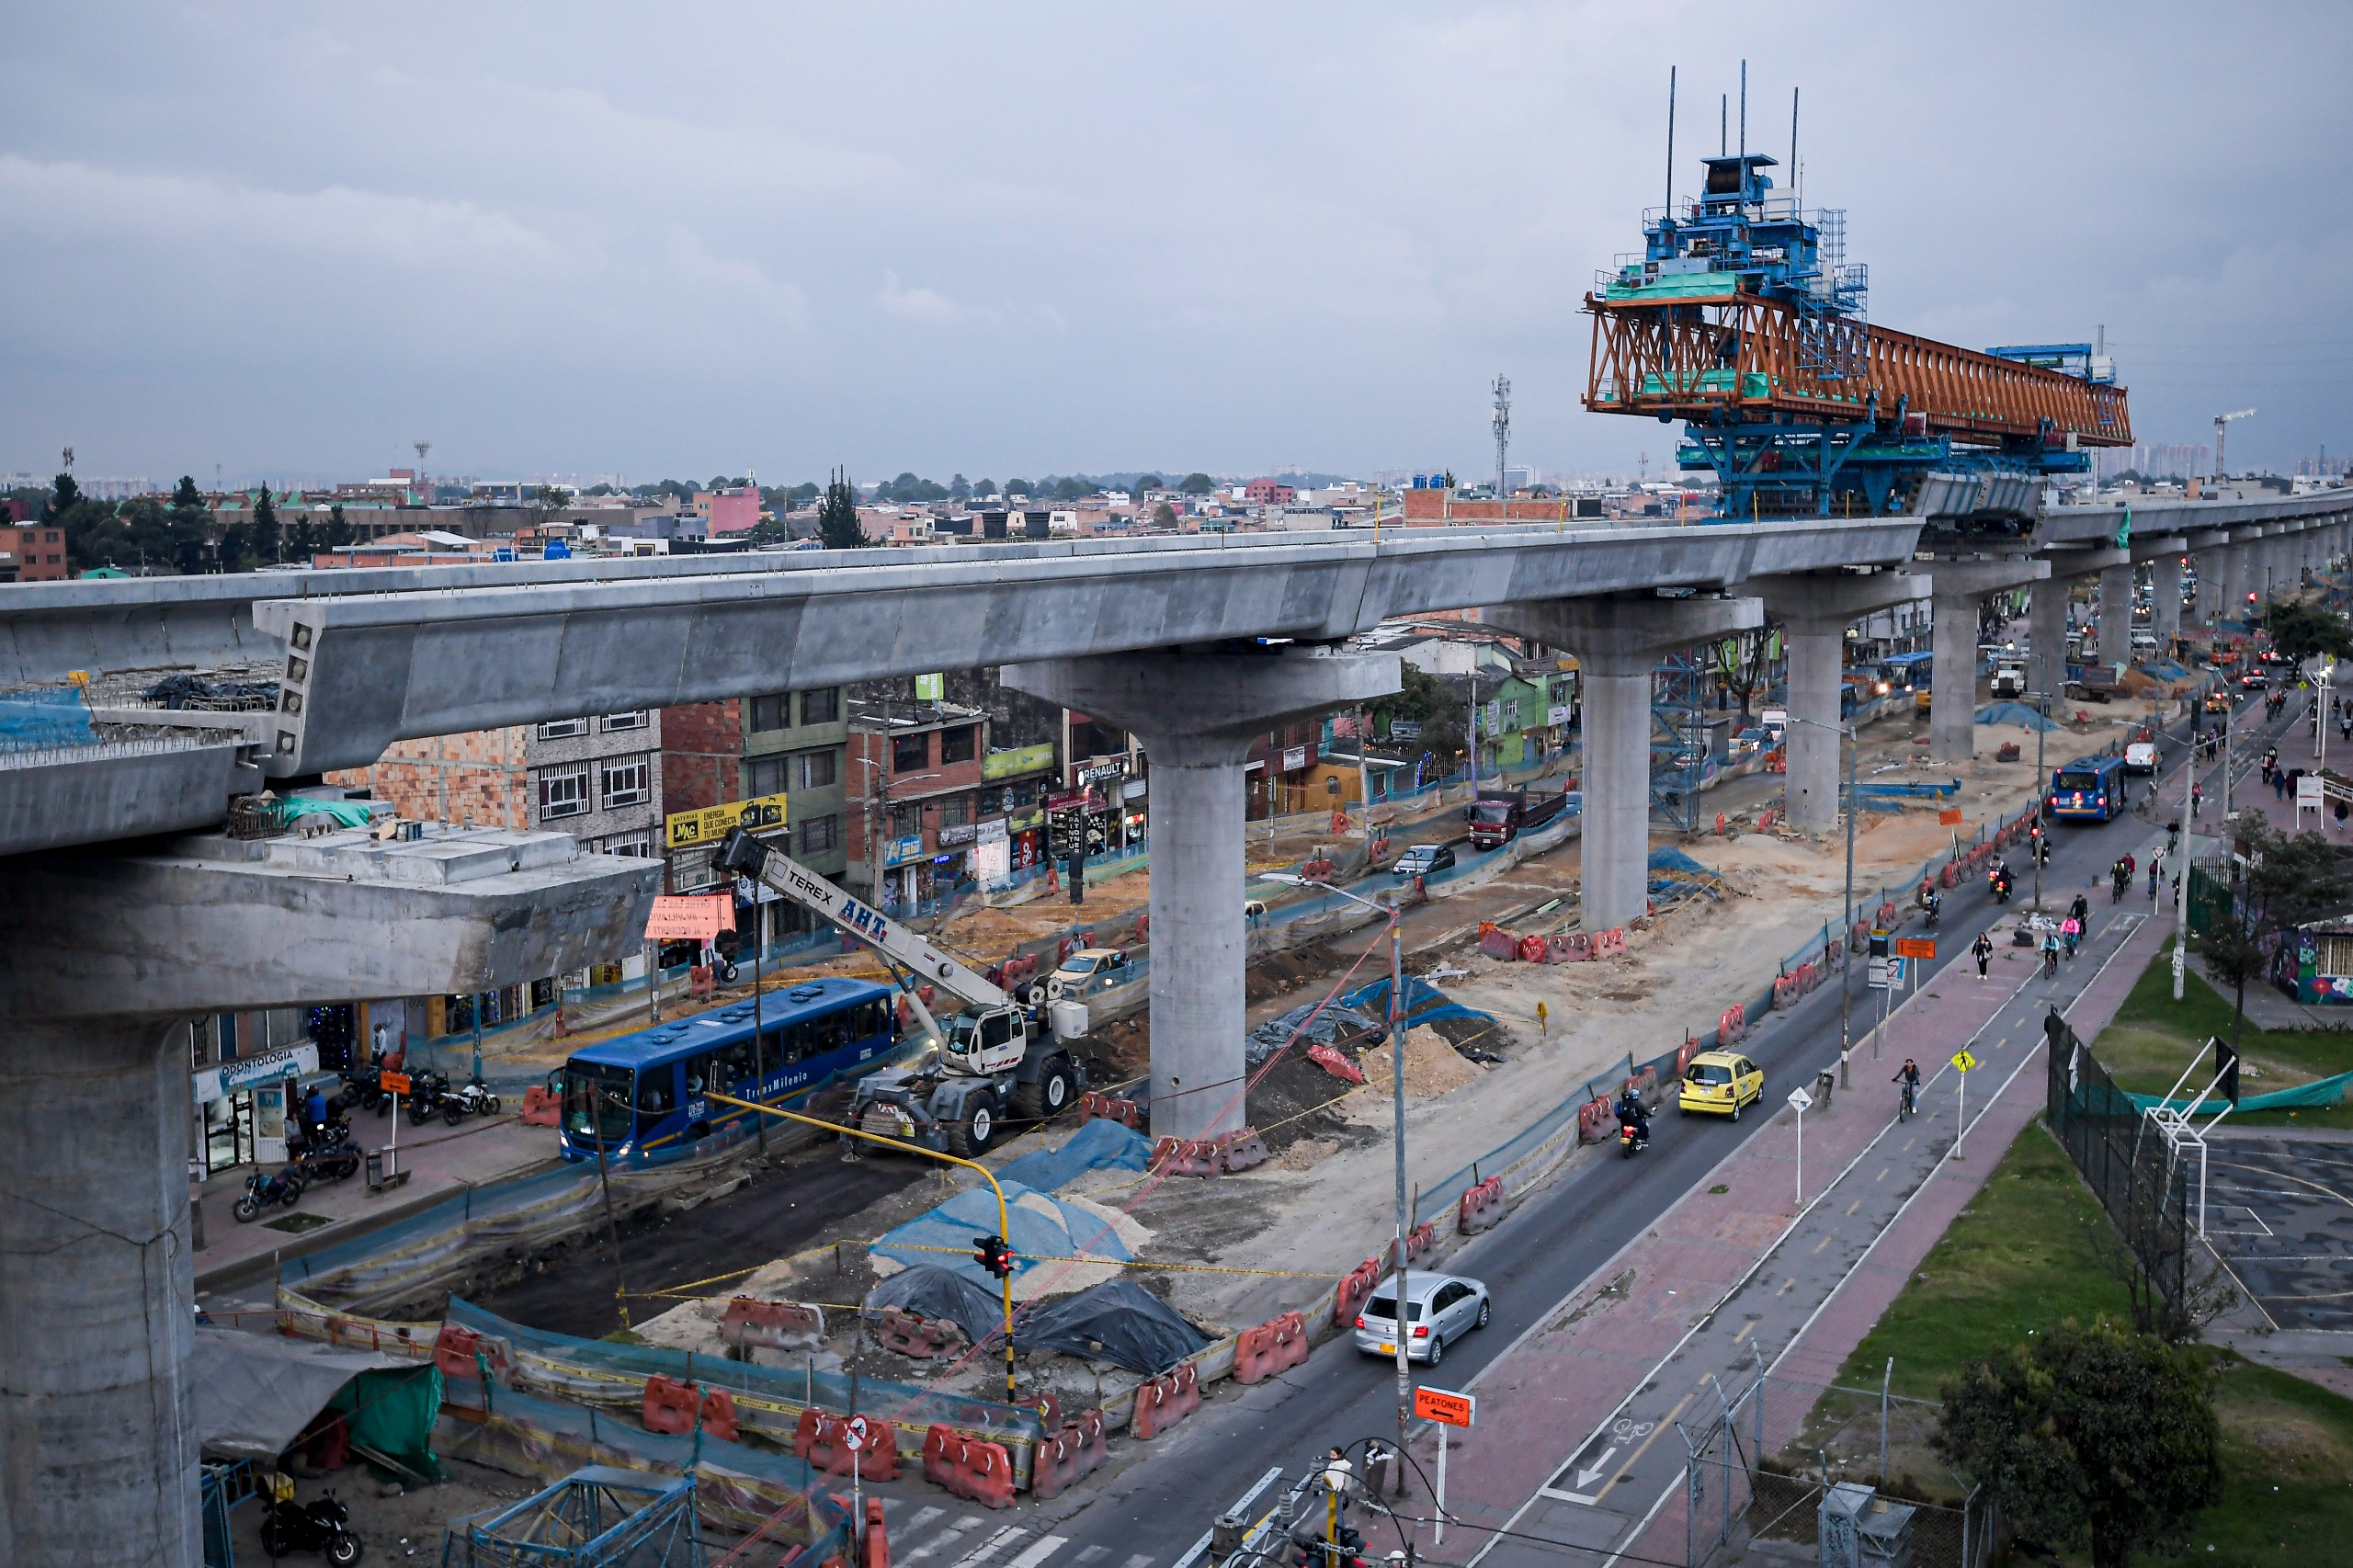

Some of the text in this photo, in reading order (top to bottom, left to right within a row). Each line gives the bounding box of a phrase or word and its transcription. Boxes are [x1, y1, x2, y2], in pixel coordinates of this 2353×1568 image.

[1085, 763, 1120, 779] RENAULT
[675, 823, 697, 840] MAC
[703, 820, 714, 830] QUE
[714, 815, 737, 827] CONECTA
[703, 830, 710, 838] TU
[789, 870, 833, 906] TEREX
[841, 899, 886, 935] AHT
[222, 1051, 293, 1076] ODONTOLOGIA
[1419, 1394, 1464, 1413] PEATONES
